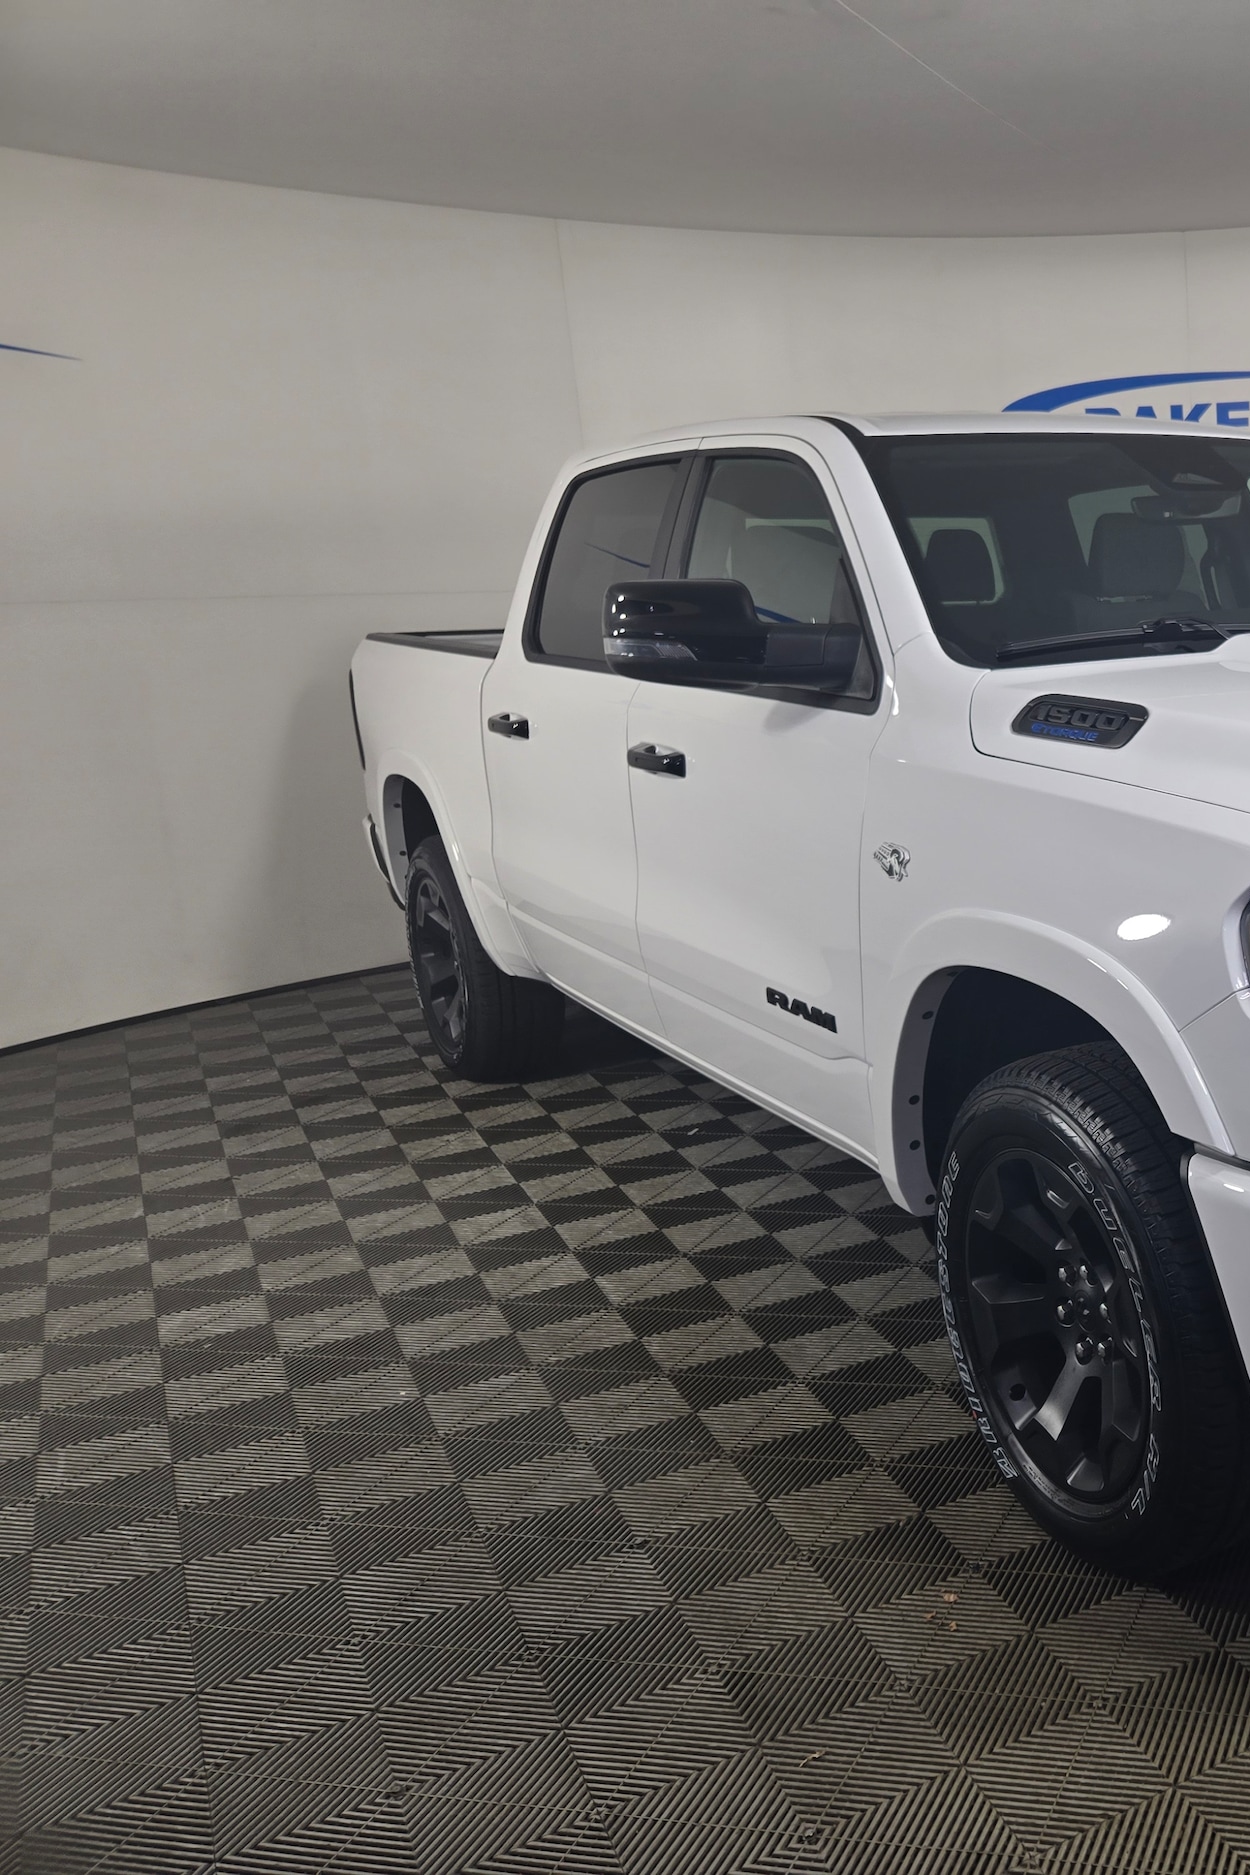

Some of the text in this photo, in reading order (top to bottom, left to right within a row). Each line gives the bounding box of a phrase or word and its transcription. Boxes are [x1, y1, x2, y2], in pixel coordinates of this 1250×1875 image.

[1030, 703, 1126, 731] 1500
[766, 986, 838, 1034] RAM
[936, 1151, 1020, 1480] BRIDGESTONE
[1068, 1161, 1162, 1412] DUELER
